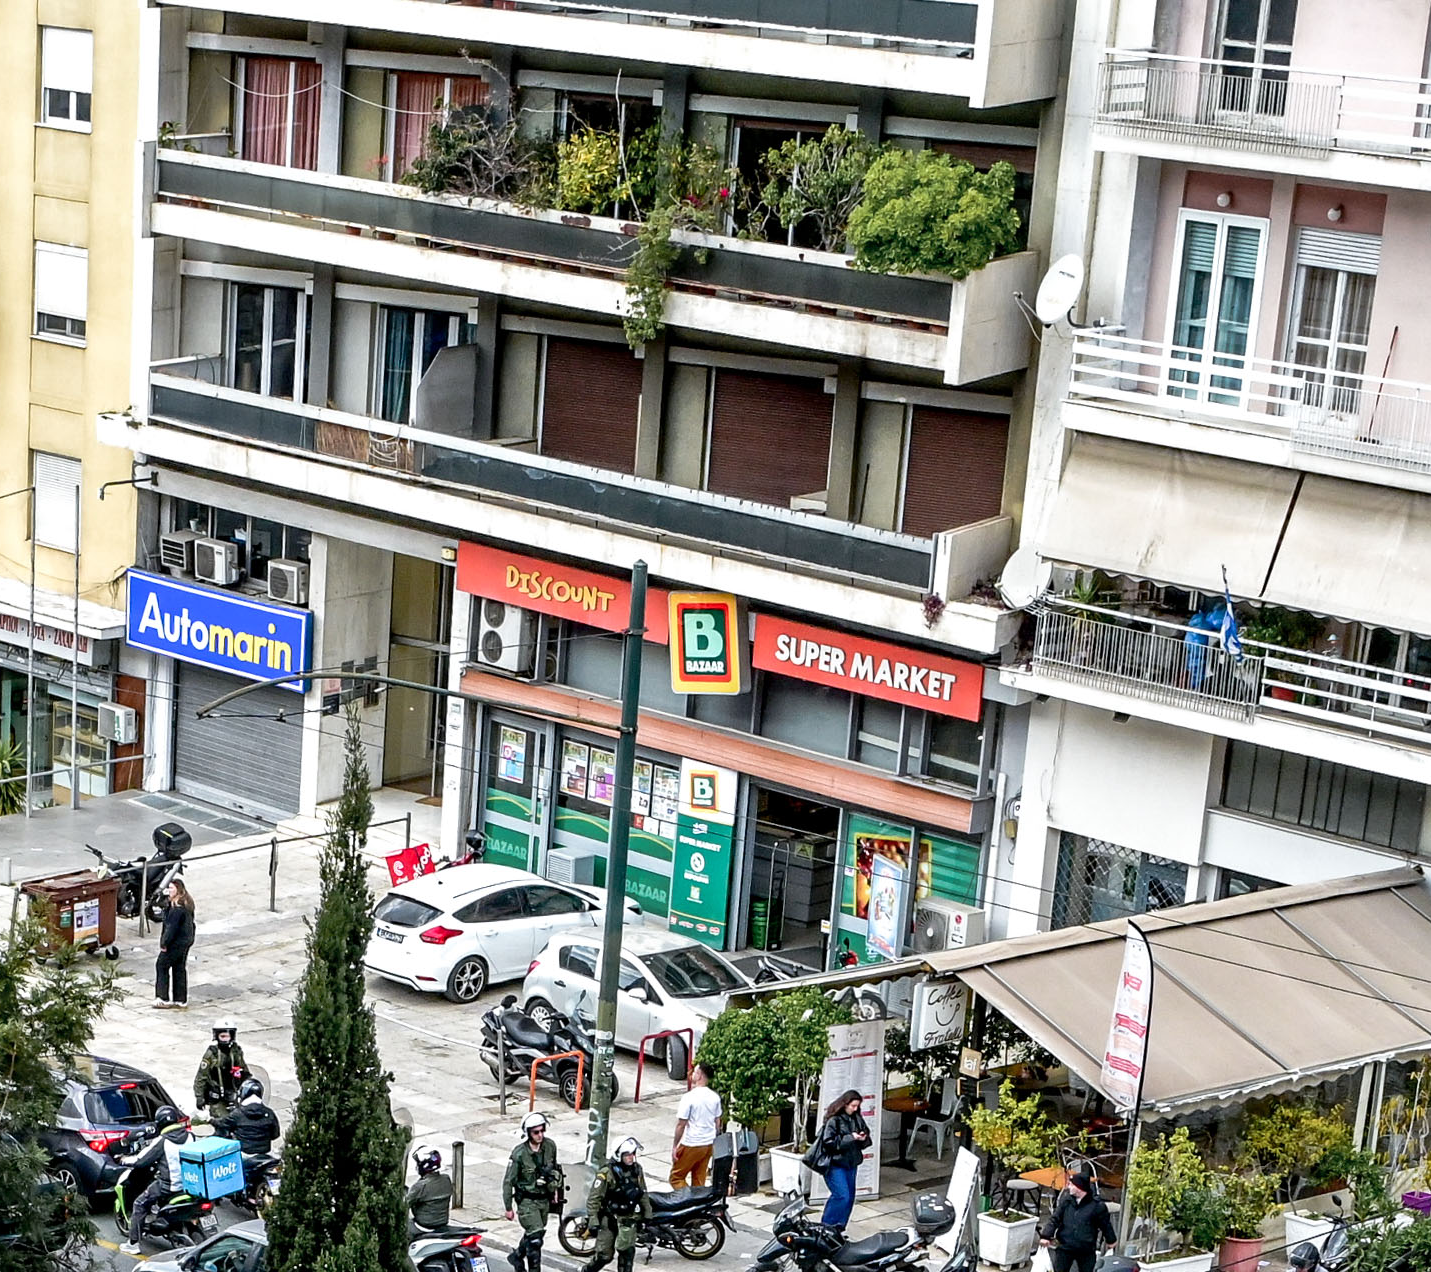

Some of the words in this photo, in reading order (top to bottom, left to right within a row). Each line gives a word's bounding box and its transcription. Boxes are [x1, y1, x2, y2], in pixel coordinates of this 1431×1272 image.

[505, 564, 616, 612] DISCOUNT
[138, 592, 292, 672] Automarin
[684, 612, 724, 659] B
[685, 659, 725, 674] BAZAAR
[775, 634, 845, 676] SUPER
[849, 654, 956, 702] MARKET
[487, 837, 528, 861] BAZAAR
